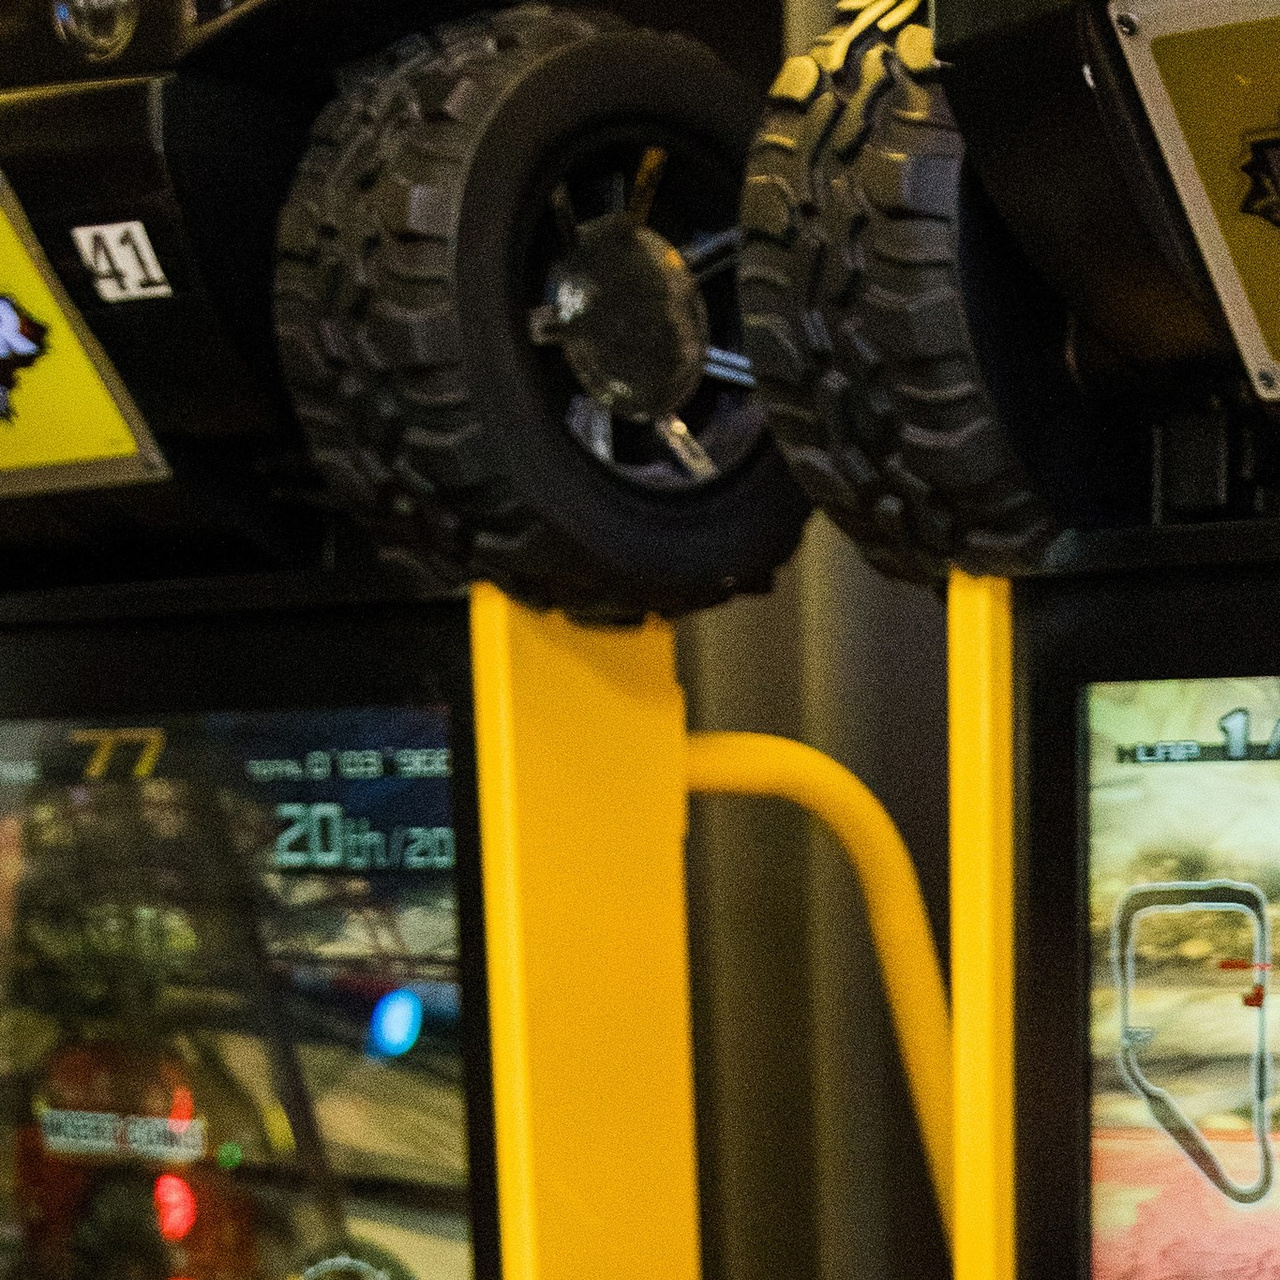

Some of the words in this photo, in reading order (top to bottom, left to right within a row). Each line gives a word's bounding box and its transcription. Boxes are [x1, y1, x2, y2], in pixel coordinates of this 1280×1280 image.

[90, 230, 166, 290] 41
[72, 728, 165, 778] 77
[1136, 741, 1199, 762] LAP
